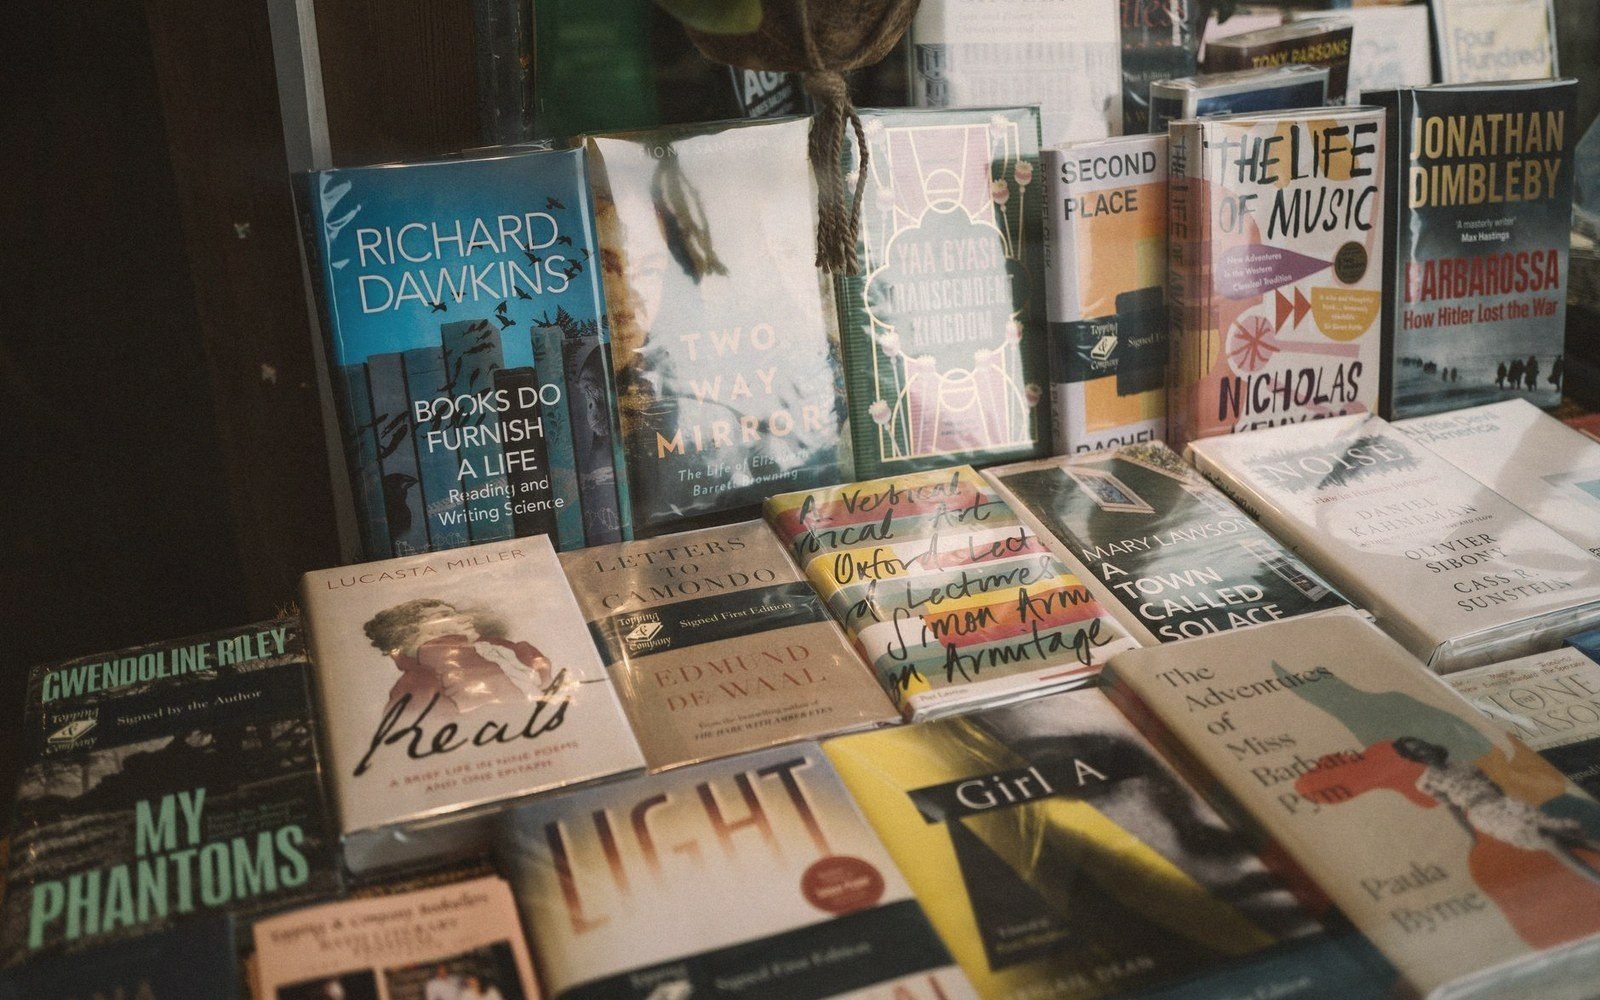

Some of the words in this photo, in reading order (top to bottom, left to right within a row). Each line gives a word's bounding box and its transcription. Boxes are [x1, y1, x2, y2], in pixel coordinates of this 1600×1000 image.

[1251, 52, 1288, 68] TONY
[1291, 39, 1349, 62] PARSONS
[1207, 134, 1284, 186] THE
[1290, 121, 1378, 180] LIFE
[1409, 110, 1565, 160] JONATHAN
[1061, 151, 1156, 184] SECOND
[1409, 158, 1562, 209] DIMBLEBY
[1064, 189, 1138, 220] PLACE
[1219, 193, 1258, 234] OF
[1267, 185, 1378, 240] MUSIC
[1464, 217, 1493, 230] masterly
[356, 212, 559, 267] RICHARD
[902, 240, 936, 274] YAA
[944, 237, 998, 272] GYASI
[1461, 233, 1477, 242] Max
[1478, 231, 1510, 242] Hastings
[358, 255, 570, 314] DAWKINS
[912, 310, 993, 346] KINGDOM
[1403, 310, 1435, 330] How
[1438, 305, 1475, 327] Hitler
[1478, 302, 1504, 322] Lost
[1507, 300, 1528, 319] the
[1532, 298, 1559, 317] War
[680, 322, 776, 362] TWO
[414, 389, 511, 423] BOOKS
[518, 383, 561, 410] DO
[689, 367, 778, 405] WAY
[1218, 361, 1363, 422] NICHOLAS
[427, 416, 544, 453] FURNISH
[656, 404, 824, 458] MIRROR
[457, 458, 478, 480] A
[484, 449, 538, 476] LIFE
[678, 468, 702, 482] The
[707, 462, 731, 477] Life
[736, 457, 748, 471] of
[742, 468, 798, 486] Browning
[1255, 443, 1404, 482] NOISE
[449, 482, 515, 503] Reading
[521, 475, 549, 492] and
[842, 471, 961, 514] Vertical
[439, 506, 499, 526] Writing
[505, 496, 565, 516] Science
[1349, 503, 1479, 538] KAHNEMAN
[1356, 497, 1439, 521] DANIEL
[593, 536, 747, 574] LETTERS
[1082, 536, 1152, 562] MARY
[1153, 515, 1257, 547] LAWSON
[1404, 533, 1498, 561] OLIVIER
[327, 564, 438, 591] LUCASTA
[447, 549, 527, 570] MILLER
[659, 563, 699, 578] TO
[834, 533, 939, 585] Oxford
[1100, 561, 1128, 580] A
[1425, 548, 1509, 574] SIBONY
[602, 568, 776, 610] CAMONDO
[908, 555, 1053, 609] Lectures
[1113, 566, 1224, 600] TOWN
[1453, 573, 1511, 594] CASS
[1513, 568, 1540, 579] R.
[1457, 576, 1574, 613] SUNSTEIN
[618, 612, 660, 627] Topping
[679, 614, 719, 629] Signed
[721, 609, 747, 622] First
[749, 601, 792, 616] Edition
[1139, 584, 1264, 621] CALLED
[888, 606, 1000, 661] Simon
[1159, 603, 1285, 643] SOLACE
[629, 636, 671, 651] Company
[943, 617, 1114, 684] Armitage
[42, 643, 212, 704] GWENDOLINE
[217, 627, 287, 667] RILEY
[654, 644, 811, 690] EDMUND
[1156, 664, 1216, 688] The
[52, 707, 99, 724] Topping
[117, 708, 163, 726] Signed
[167, 705, 182, 717] by
[187, 700, 209, 712] the
[213, 689, 263, 706] Author
[667, 691, 710, 713] DE
[719, 667, 827, 699] WAAL
[1185, 665, 1334, 713] Adventures
[353, 667, 600, 777] Keats
[716, 725, 742, 737] HARE
[745, 719, 772, 730] WITH
[775, 711, 808, 724] AMBER
[1207, 711, 1237, 736] of
[389, 779, 399, 788] A
[404, 770, 440, 785] BRIEF
[445, 764, 471, 776] LIFE
[495, 752, 530, 766] NINE
[534, 741, 579, 757] POEMS
[1226, 732, 1298, 762] Miss
[426, 779, 458, 793] AND
[461, 772, 493, 785] ONE
[498, 759, 553, 779] EPITAPH
[955, 765, 1054, 810] Girl
[1073, 758, 1108, 787] A
[1251, 747, 1367, 788] Barbara
[135, 787, 207, 857] MY
[545, 756, 834, 936] LIGHT
[27, 825, 310, 950] PHANTOMS
[1360, 861, 1450, 902] Paula
[1390, 891, 1487, 934] Byrne
